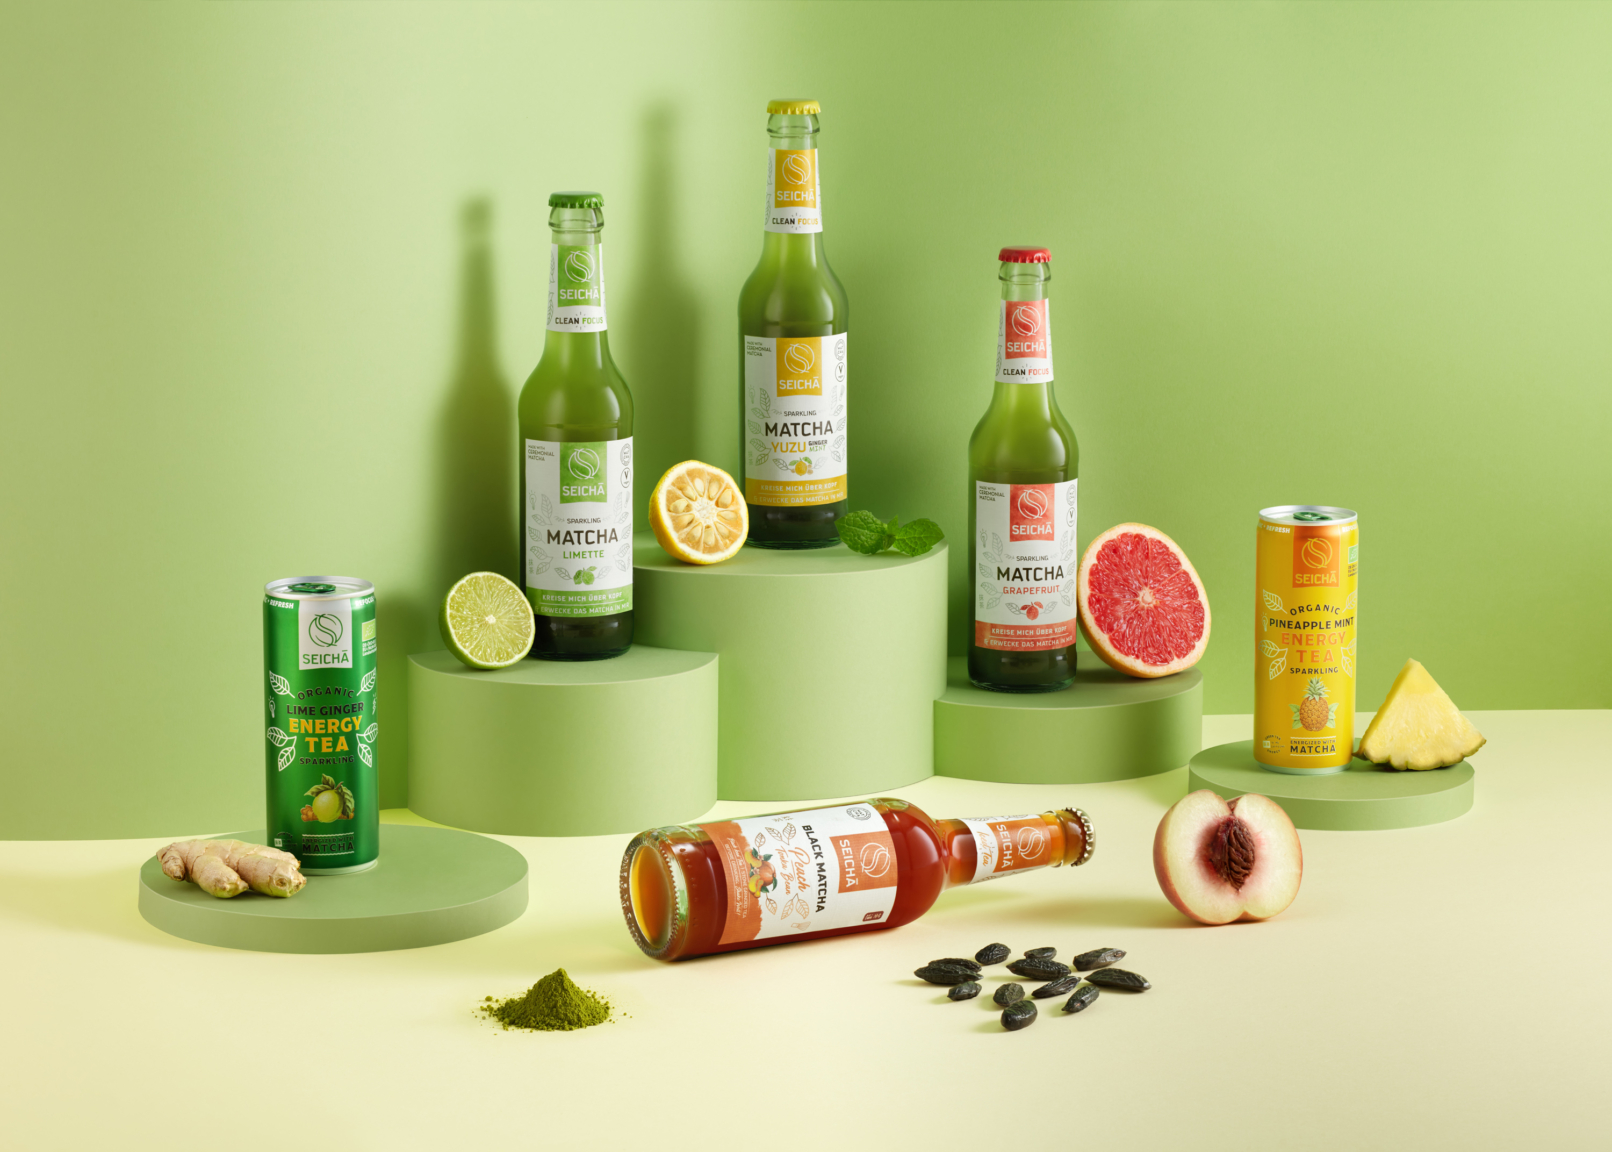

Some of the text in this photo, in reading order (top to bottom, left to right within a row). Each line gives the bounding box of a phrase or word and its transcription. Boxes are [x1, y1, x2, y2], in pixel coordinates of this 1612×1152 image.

[777, 189, 814, 201] SEICHĀ
[560, 286, 599, 300] SEICHĀ
[1007, 339, 1045, 352] SEICHĀ
[779, 376, 820, 390] SEICHĀ
[765, 420, 833, 437] MATCHA
[771, 442, 806, 453] YUZU
[562, 483, 605, 496] SEICHĀ
[1012, 522, 1052, 535] SEICHĀ
[1266, 524, 1290, 533] REFRESH
[547, 528, 618, 545] MATCHA
[563, 550, 604, 559] LIMETTE
[997, 565, 1064, 582] MATCHA
[1295, 571, 1337, 584] SEICHĀ
[1003, 585, 1060, 595] GRAPEFRUIT
[270, 599, 294, 609] REFRESH
[1290, 604, 1340, 616] ORGANIC
[1270, 617, 1354, 630] PINEAPPLE MINT
[1281, 631, 1346, 646] ENERGY
[303, 650, 349, 664] SEICHĀ
[1296, 649, 1334, 663] TEA
[298, 686, 355, 700] ORGANIC
[286, 702, 364, 716] LIME GINGER
[289, 715, 362, 733] ENERGY
[305, 736, 349, 753] TEA
[1290, 744, 1336, 753] MATCHA
[300, 755, 354, 765] SPARKLING
[303, 842, 354, 852] MATCHA
[725, 844, 734, 860] BEFORE
[996, 824, 1014, 869] SEICHĀ
[839, 839, 858, 888] SEICHĀ
[983, 848, 992, 867] Tea
[775, 846, 794, 896] Tonka Bean
[788, 847, 810, 892] Peach
[802, 824, 827, 913] BLACK MATCHA
